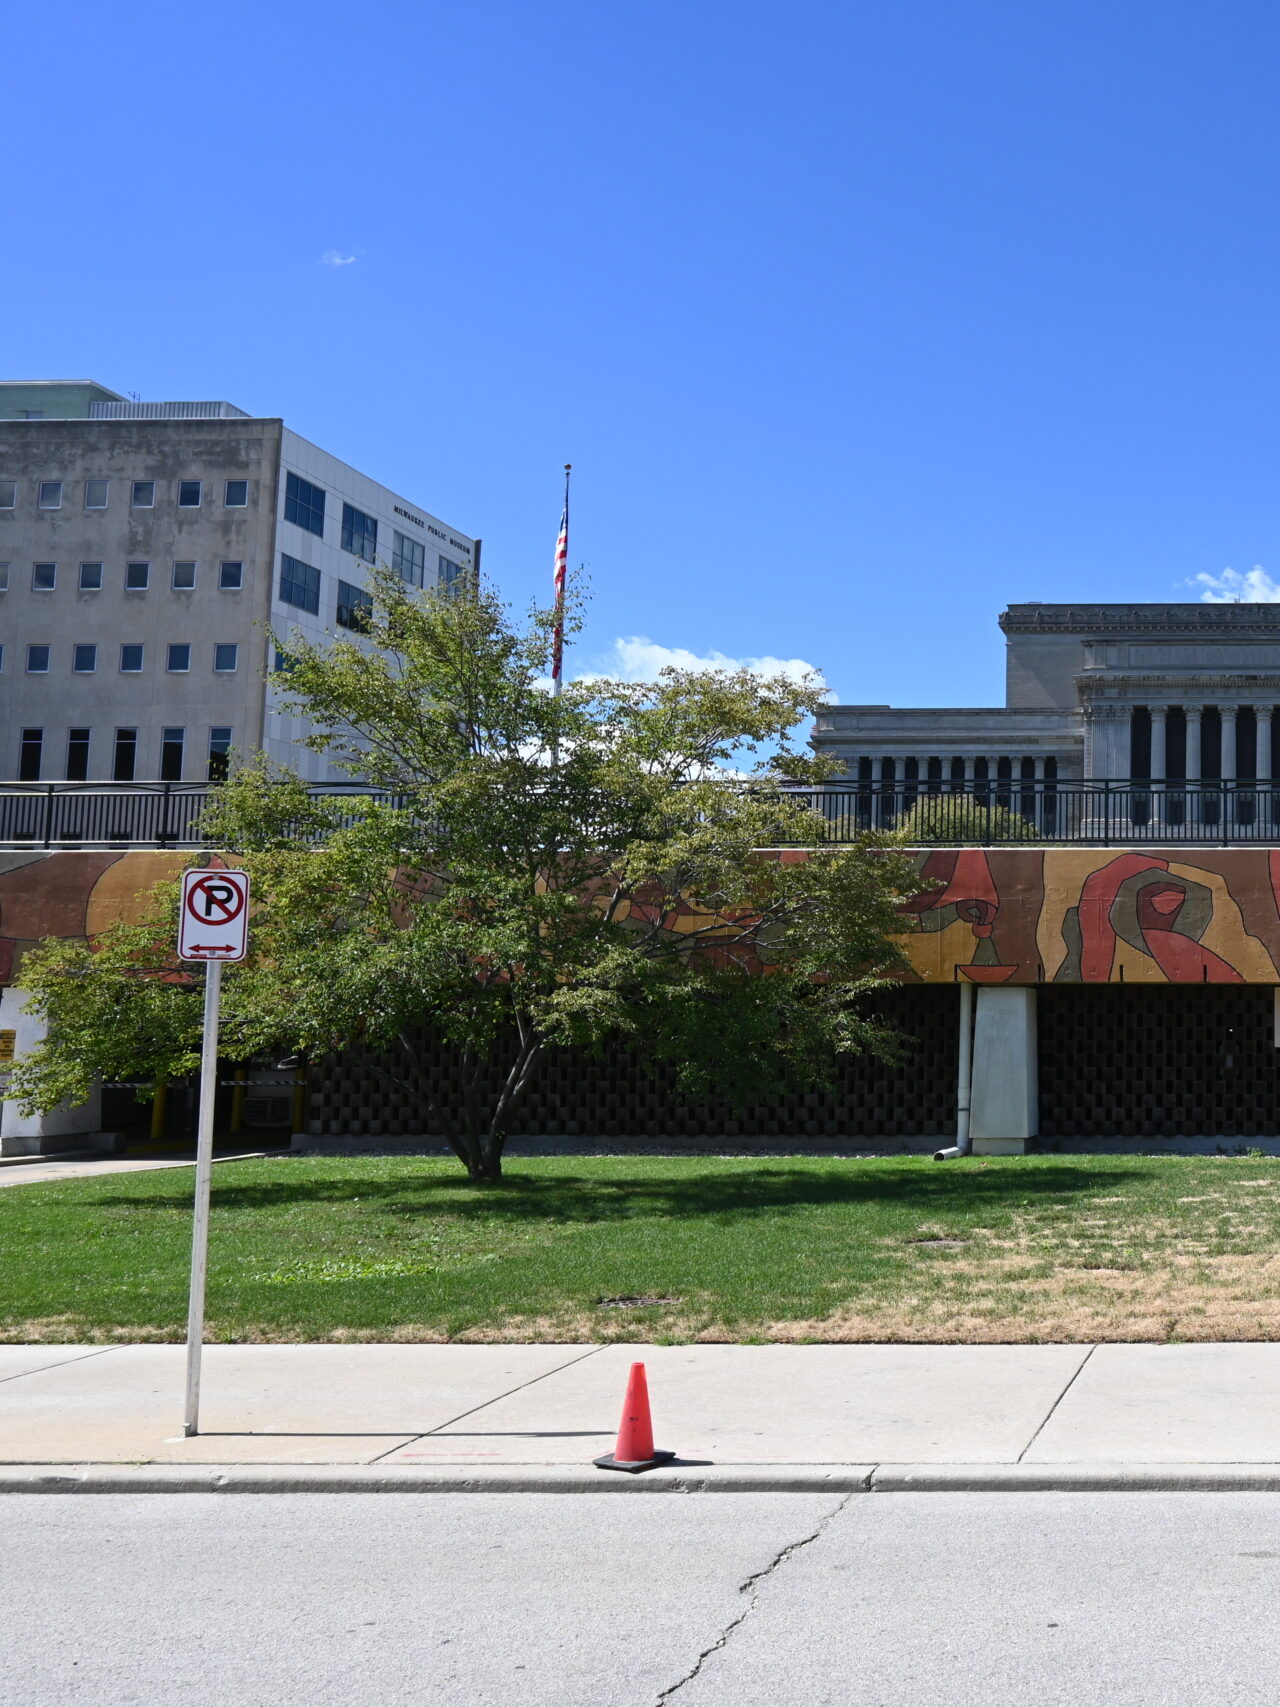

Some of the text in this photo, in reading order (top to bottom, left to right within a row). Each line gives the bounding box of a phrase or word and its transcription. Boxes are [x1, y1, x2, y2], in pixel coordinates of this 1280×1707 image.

[393, 505, 470, 554] MILWAUKEE PUBLIC MUSEUM
[205, 885, 233, 916] P
